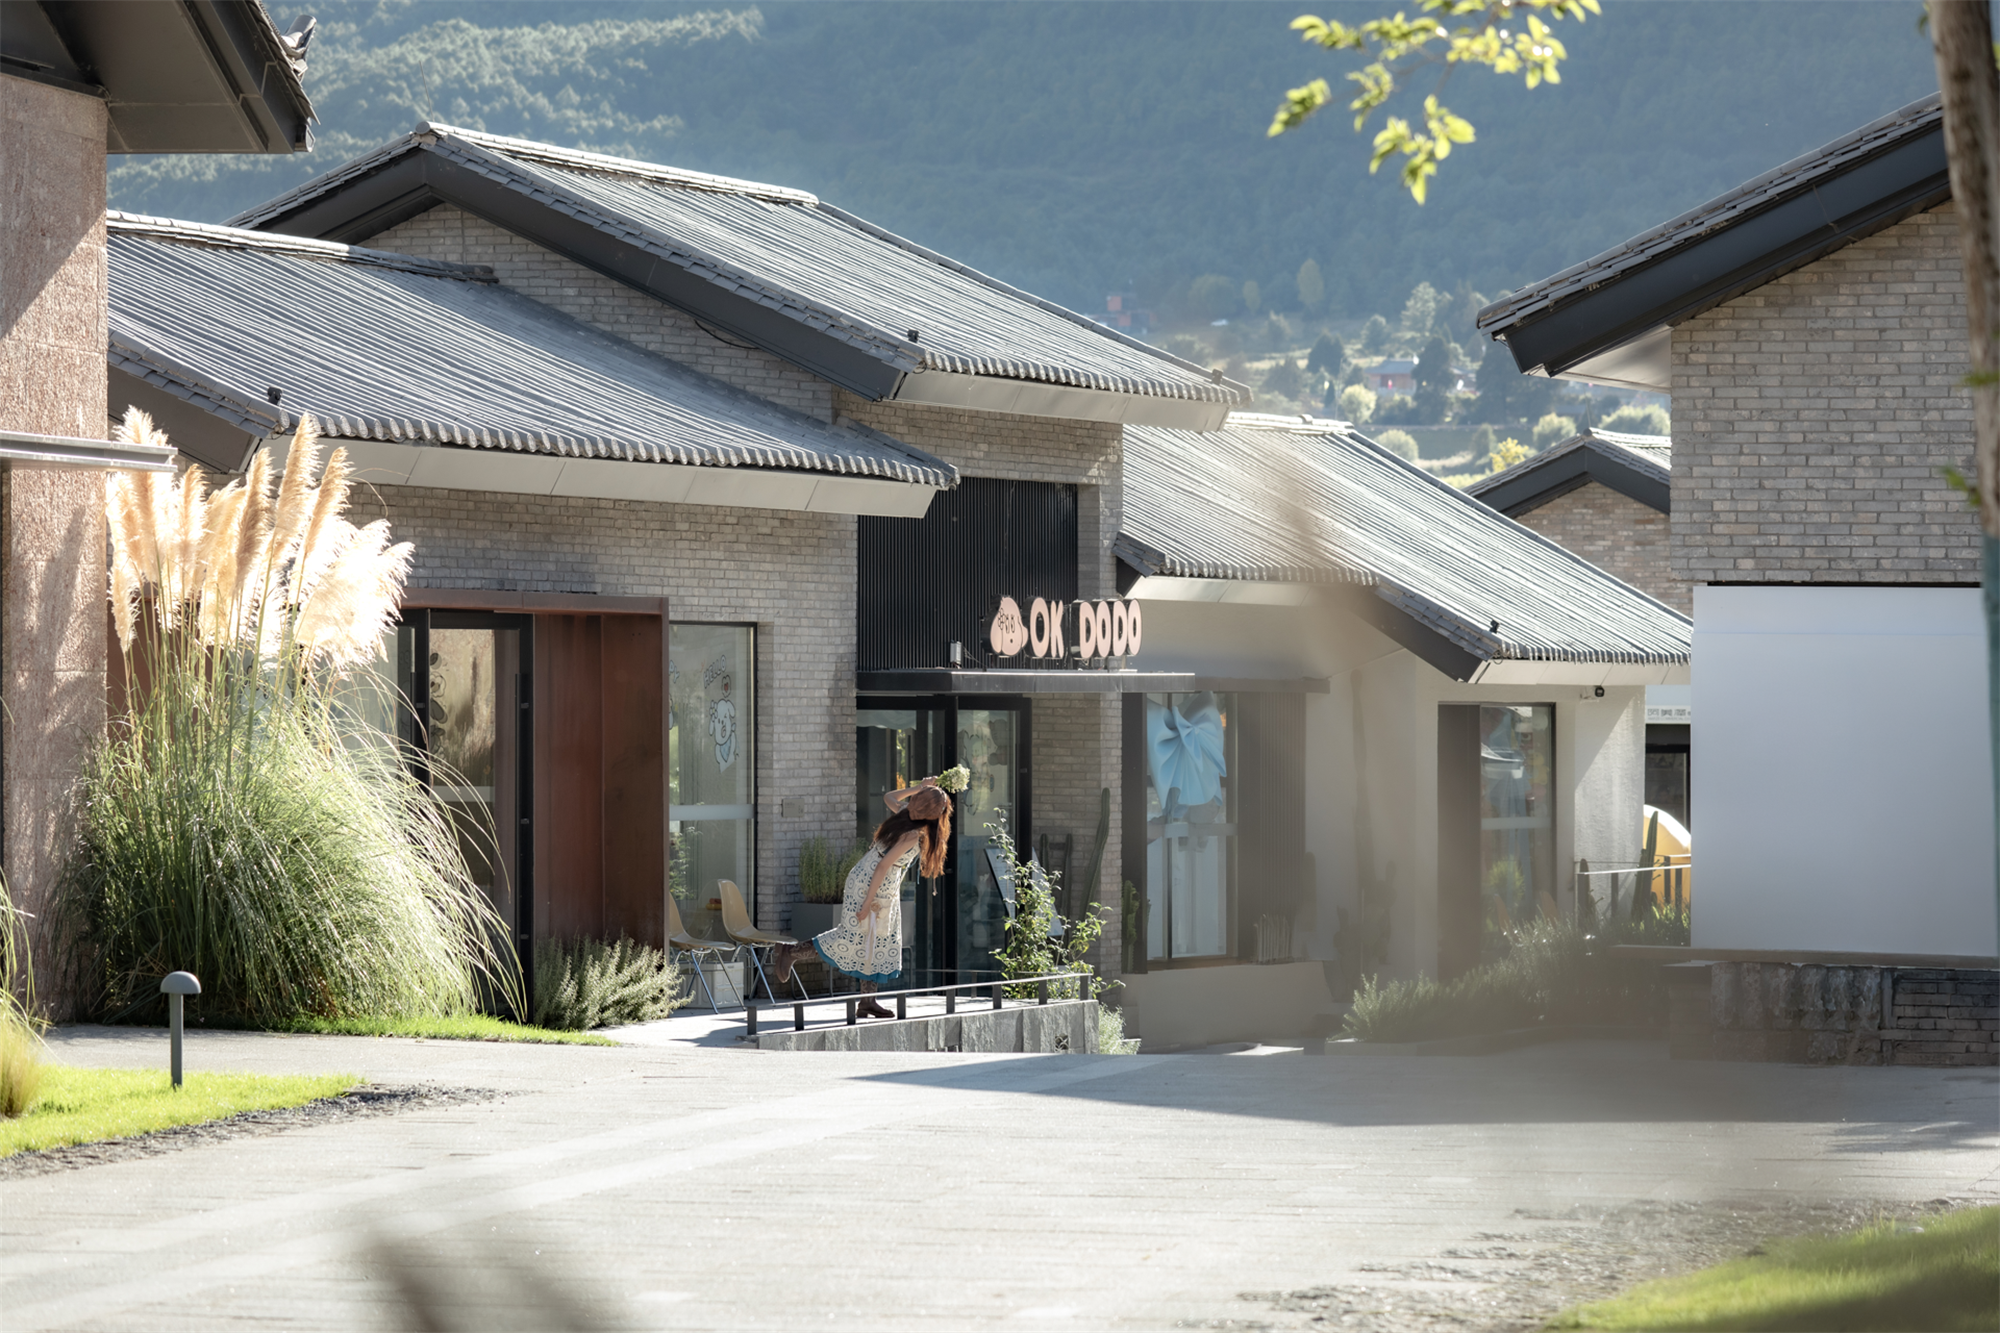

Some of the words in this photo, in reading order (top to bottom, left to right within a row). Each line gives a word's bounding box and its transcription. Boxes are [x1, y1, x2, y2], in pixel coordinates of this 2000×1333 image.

[1030, 597, 1064, 659] OK
[1079, 598, 1142, 659] DODO
[703, 654, 727, 689] HELLO
